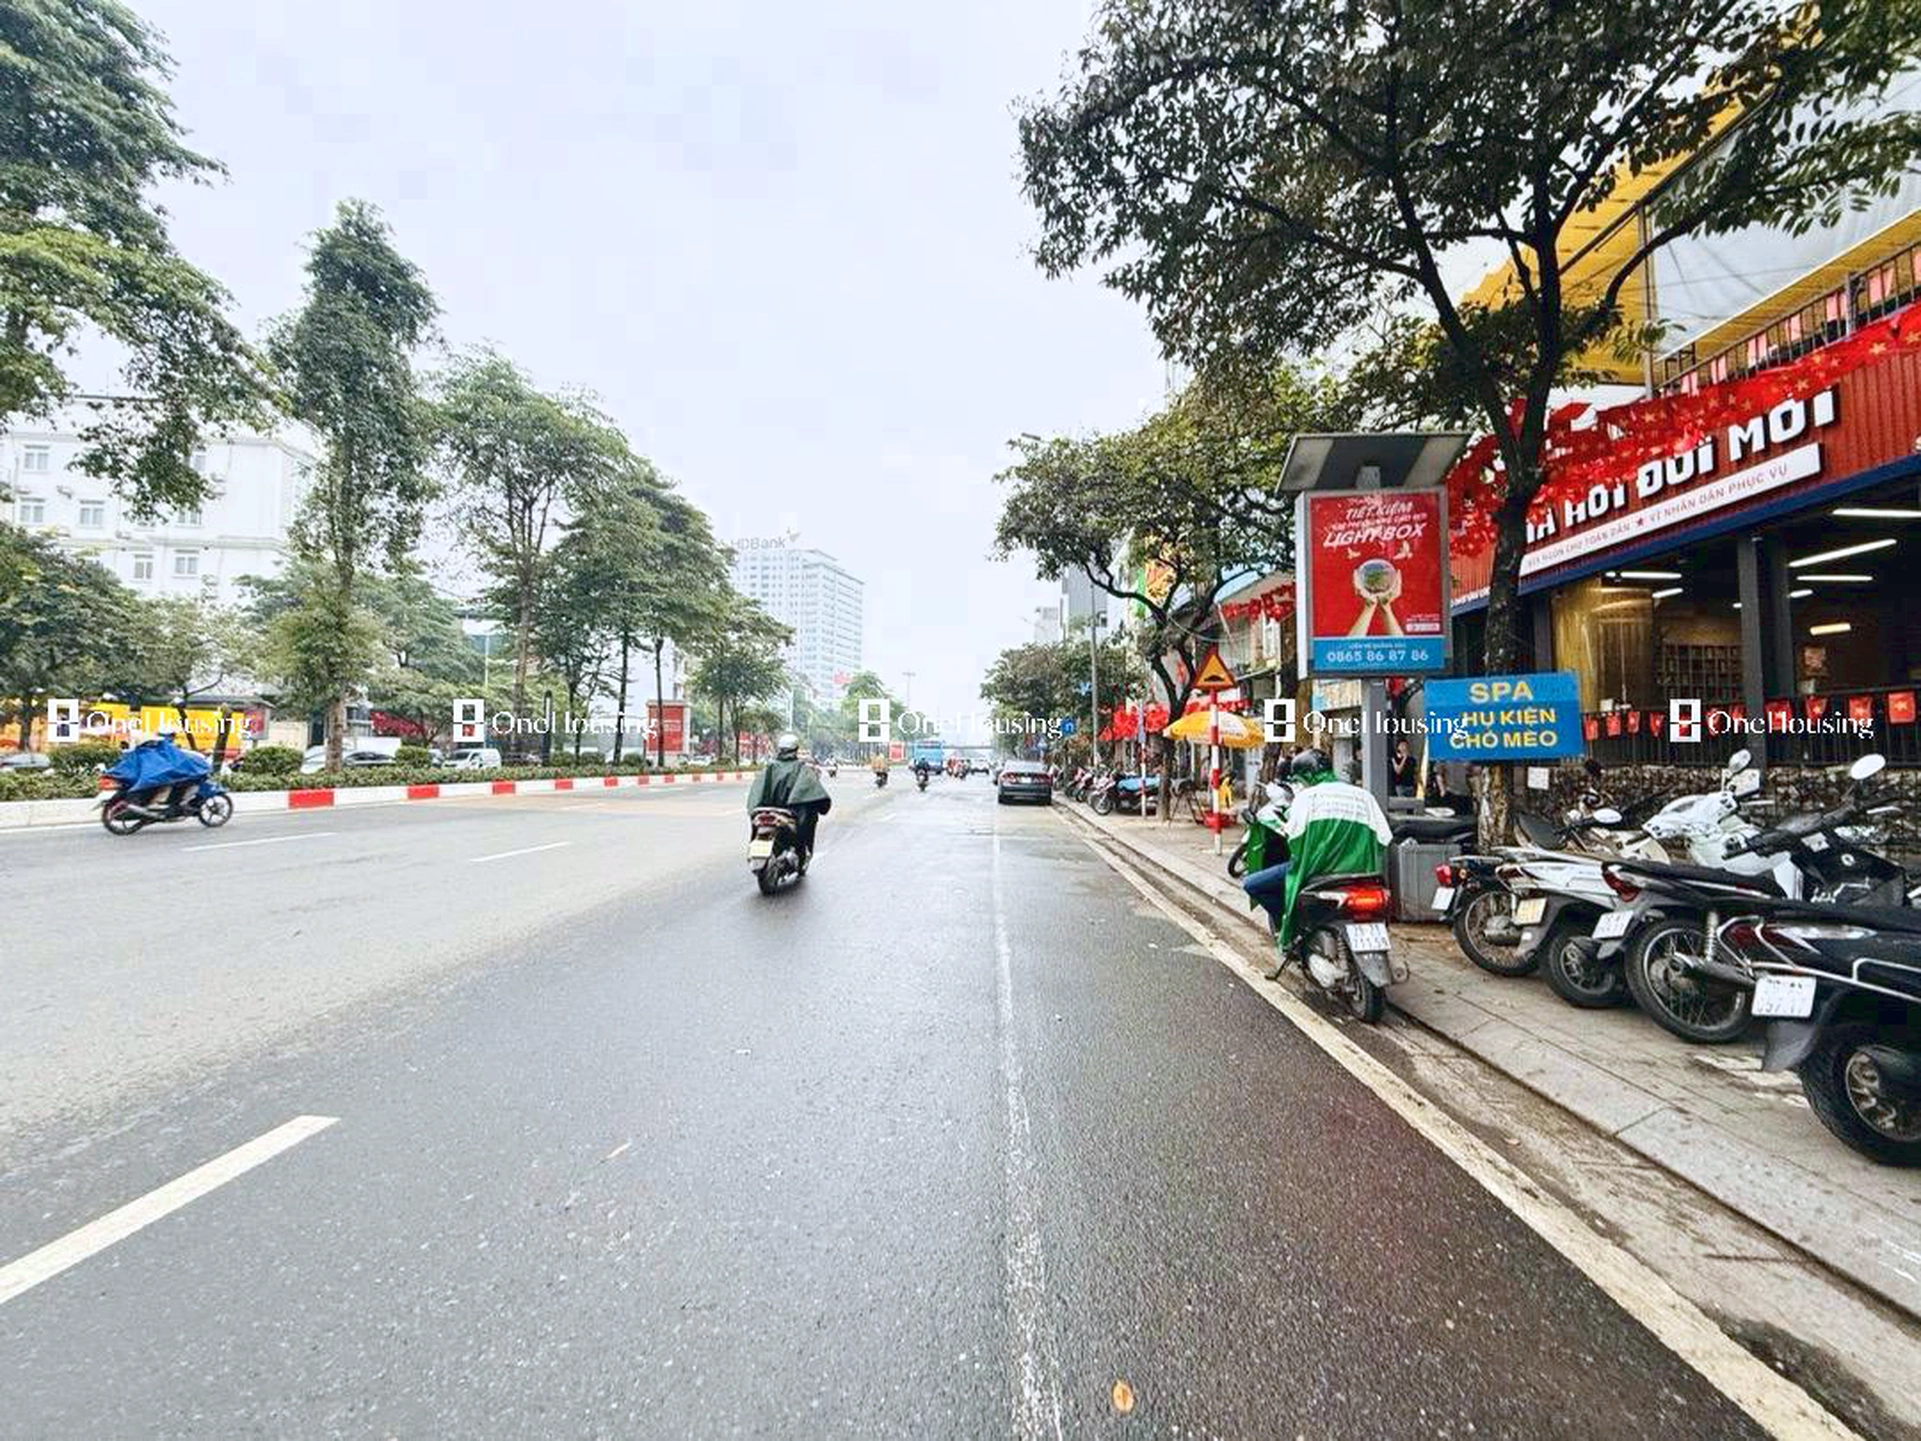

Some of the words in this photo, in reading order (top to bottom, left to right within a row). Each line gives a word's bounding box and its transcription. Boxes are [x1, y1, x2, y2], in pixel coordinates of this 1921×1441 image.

[730, 536, 786, 550] HDBank
[1326, 650, 1363, 663] 0865
[1366, 649, 1385, 662] 86
[1388, 649, 1407, 662] 87
[1411, 648, 1430, 661] 86
[1469, 680, 1535, 705] SPA
[1500, 706, 1557, 728] KIỆN
[1503, 727, 1559, 749] MÈO
